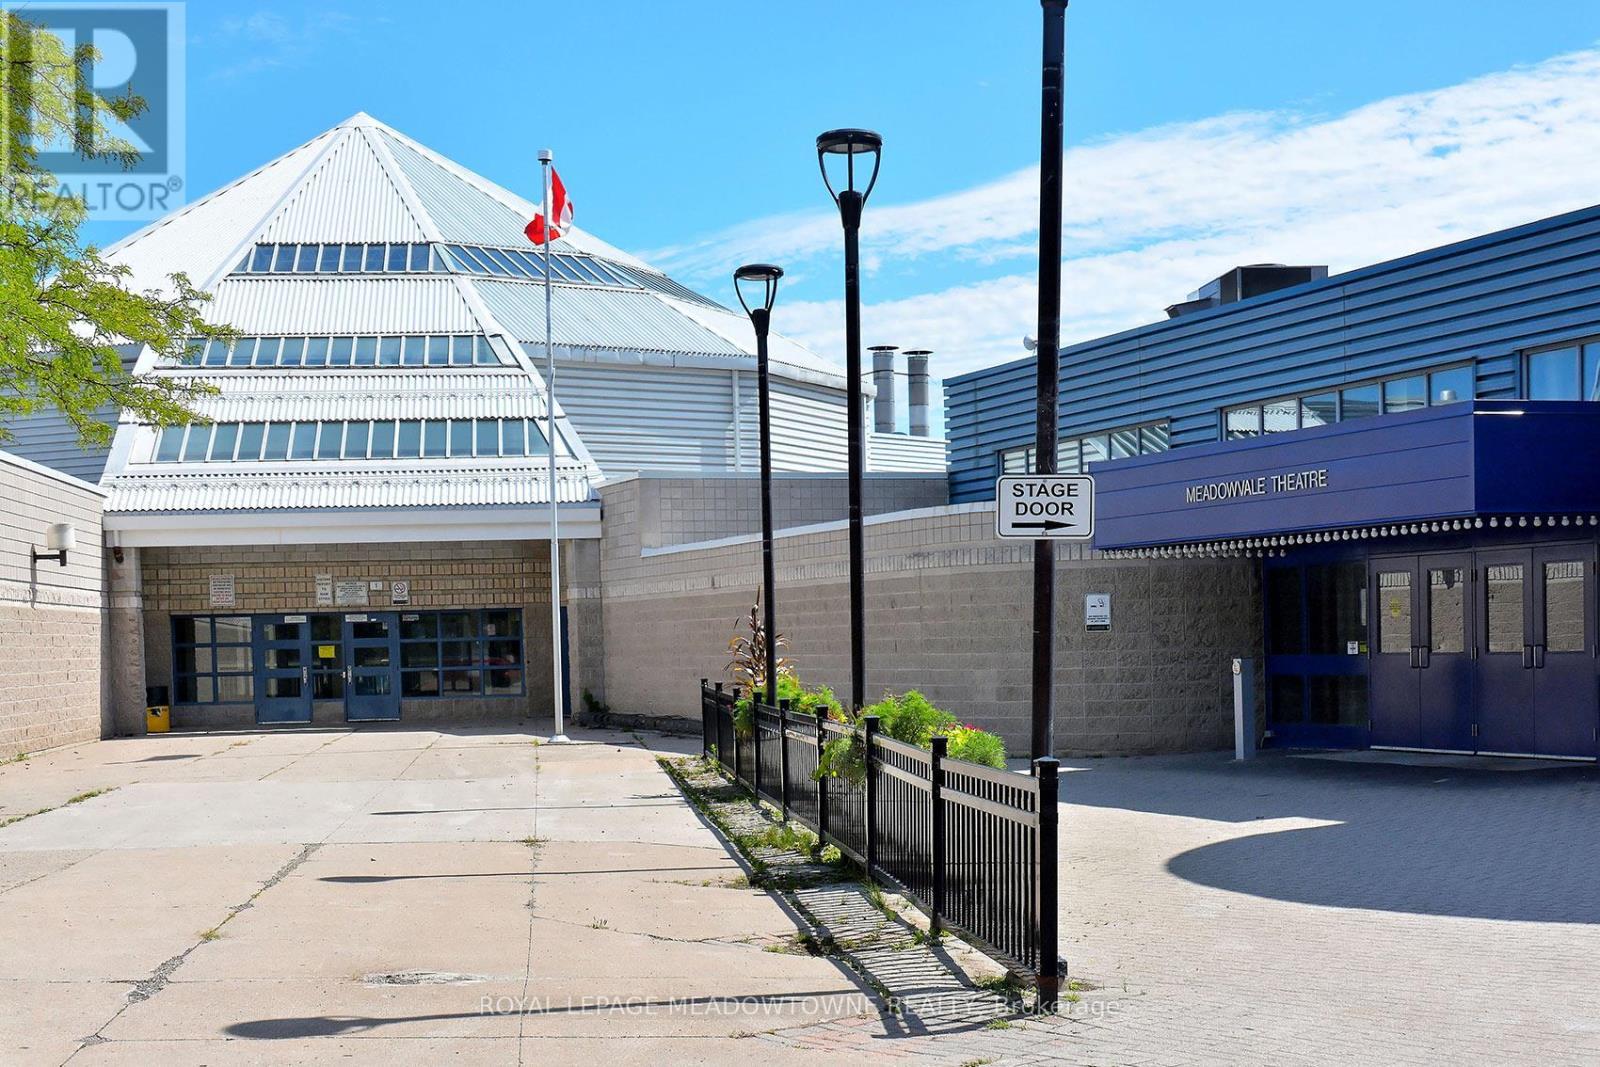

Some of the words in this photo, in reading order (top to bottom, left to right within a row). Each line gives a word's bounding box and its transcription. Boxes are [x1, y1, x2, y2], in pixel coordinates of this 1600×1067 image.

[1012, 483, 1079, 498] STAGE
[1186, 477, 1266, 503] MEADOWVALE
[1271, 469, 1328, 493] THEATRE
[1015, 502, 1075, 516] DOOR
